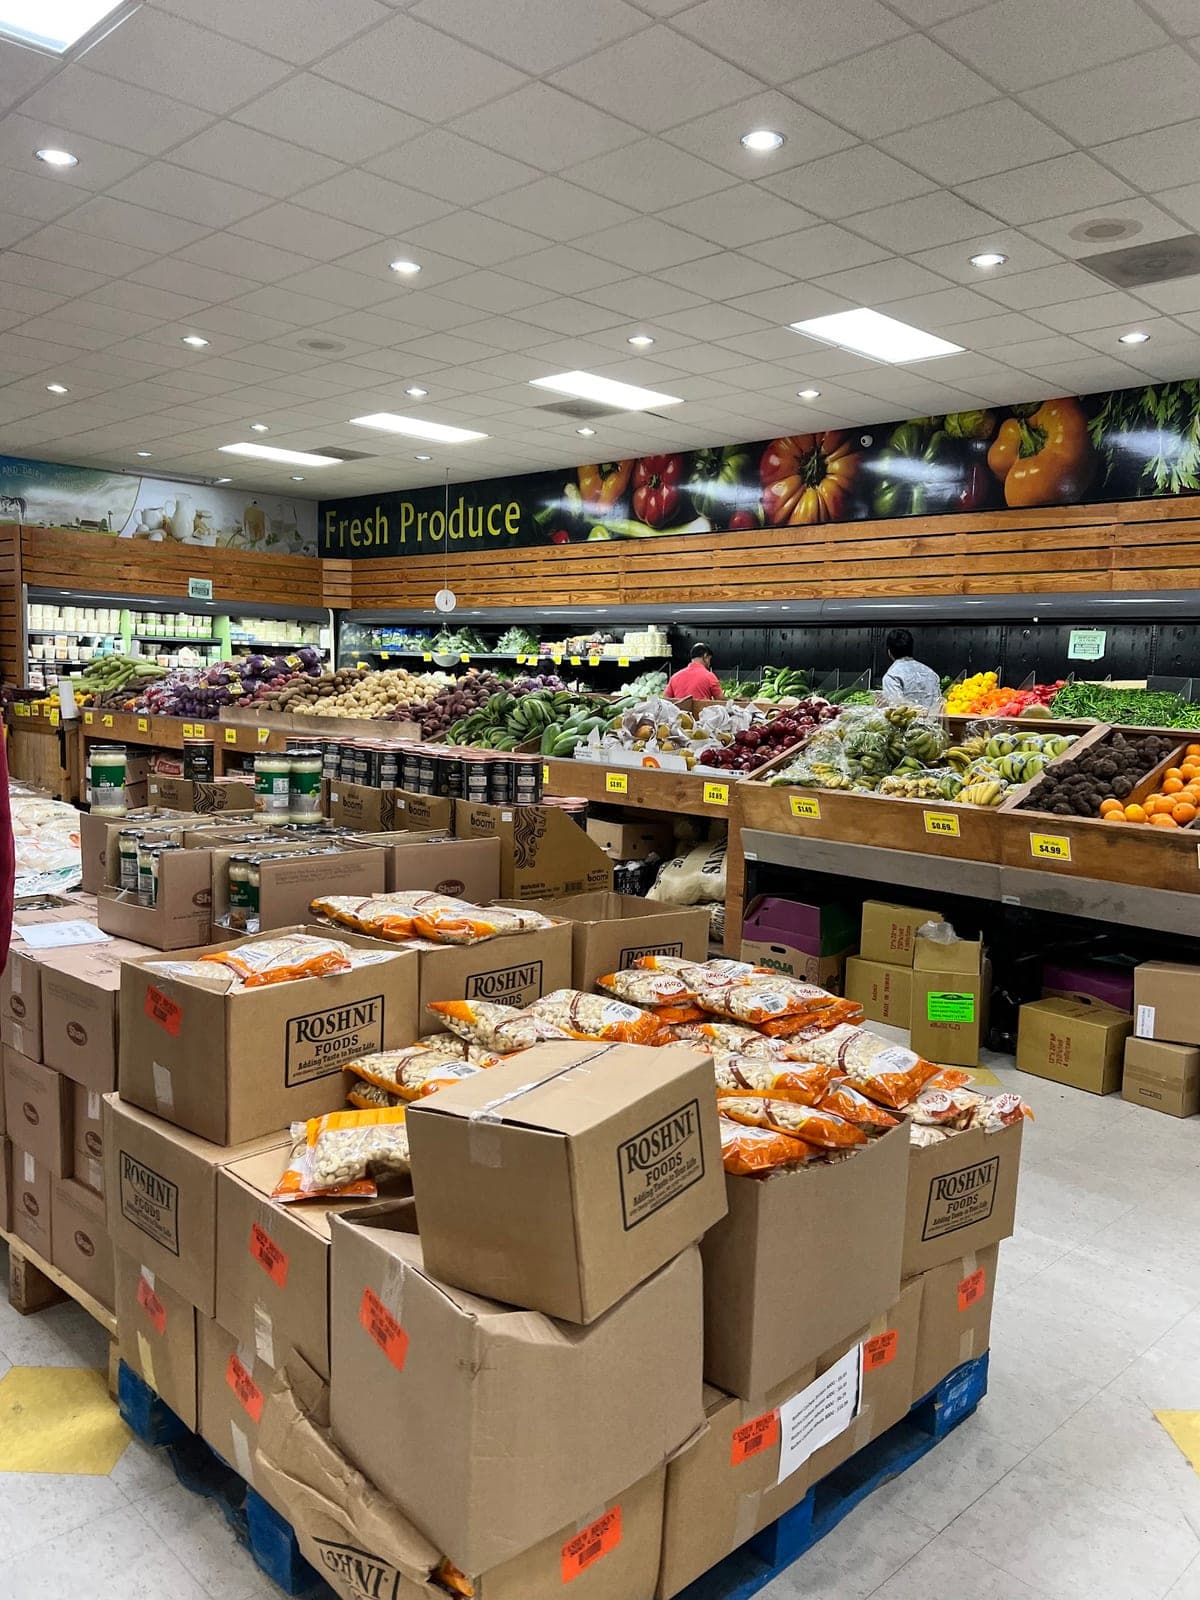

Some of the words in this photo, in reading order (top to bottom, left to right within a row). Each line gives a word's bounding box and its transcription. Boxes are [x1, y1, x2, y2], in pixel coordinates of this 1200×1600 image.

[325, 505, 389, 548] Fresh
[400, 496, 521, 543] Produce
[470, 813, 496, 829] boomi
[1039, 844, 1061, 855] $4.99
[586, 871, 609, 883] boomi
[760, 957, 794, 975] POOJA
[472, 966, 537, 998] ROSHNI
[295, 1002, 377, 1044] ROSHNI
[315, 1034, 359, 1057] FOODS
[297, 1058, 322, 1071] Adding
[625, 1110, 695, 1174] ROSHNI
[124, 1157, 171, 1209] ROSHNI
[645, 1151, 682, 1187] FOODS
[935, 1163, 993, 1201] ROSHNI
[134, 1194, 161, 1222] FOODS
[946, 1193, 979, 1214] FOODS
